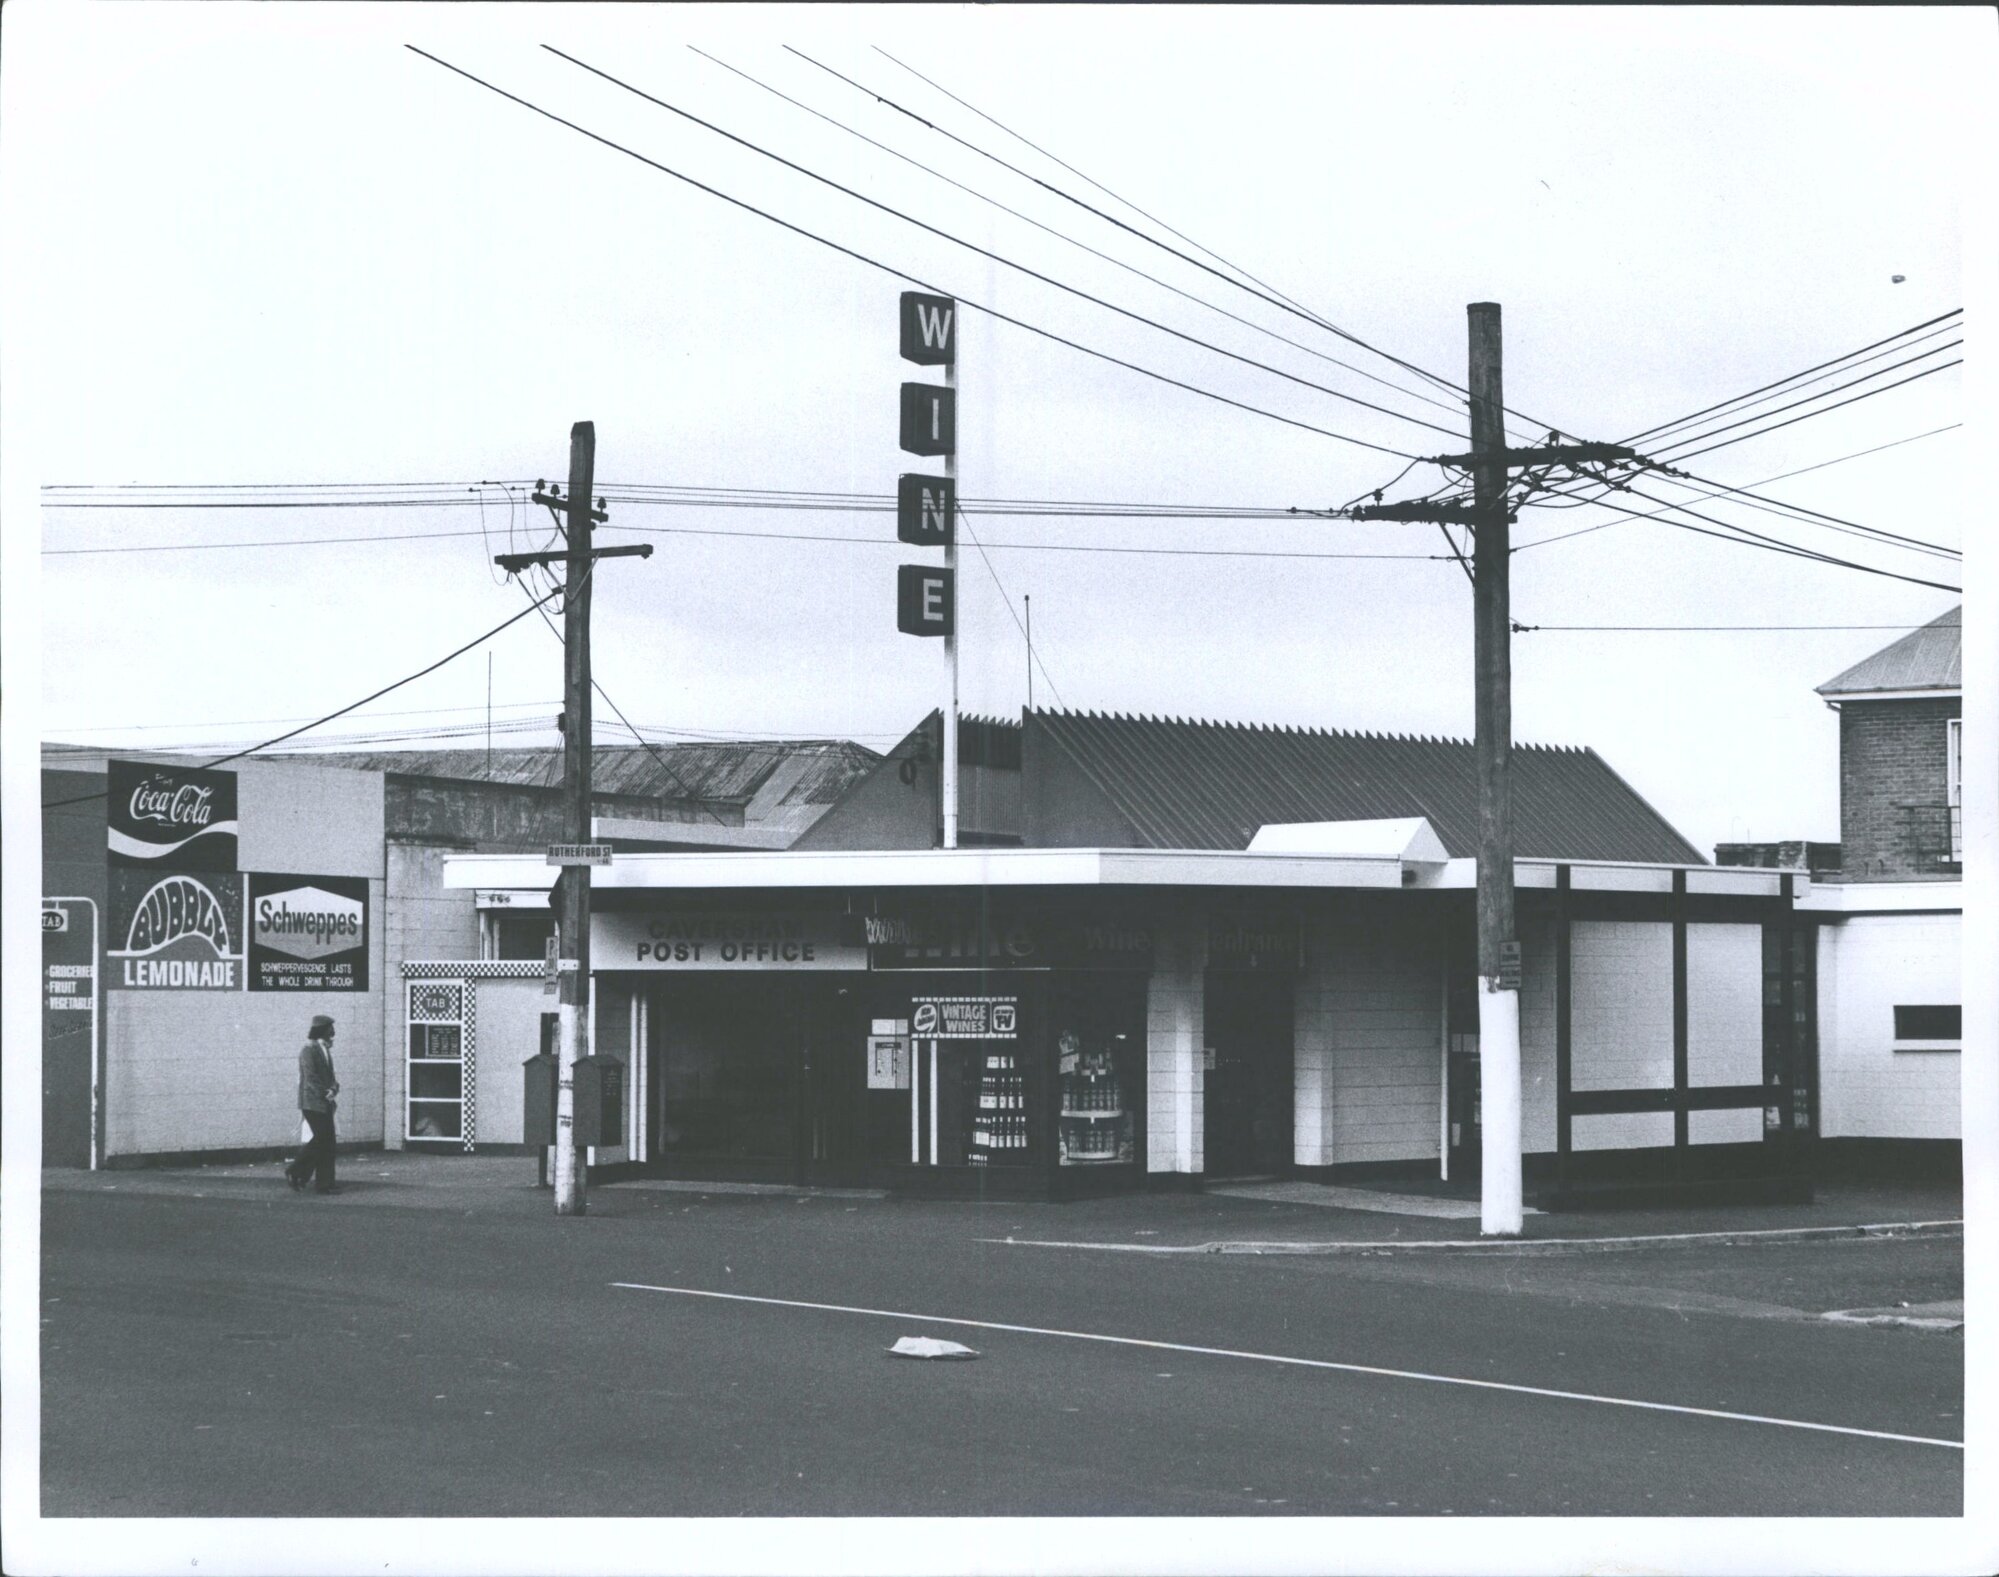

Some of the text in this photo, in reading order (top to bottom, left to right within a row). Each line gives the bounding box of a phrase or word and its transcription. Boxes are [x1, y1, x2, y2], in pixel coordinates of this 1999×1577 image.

[917, 303, 951, 622] WINE
[130, 780, 214, 824] Coca-Cola
[260, 899, 357, 945] Schweppes
[637, 942, 815, 962] POST OFFICE
[124, 960, 234, 987] LEMONADE
[330, 963, 352, 974] LASTS
[49, 981, 77, 993] FRUIT
[261, 976, 354, 987] THE WHOLE DRINK THROUGH
[425, 997, 446, 1009] TAB
[941, 1003, 987, 1020] VINTAGE
[945, 1020, 985, 1033] WINES
